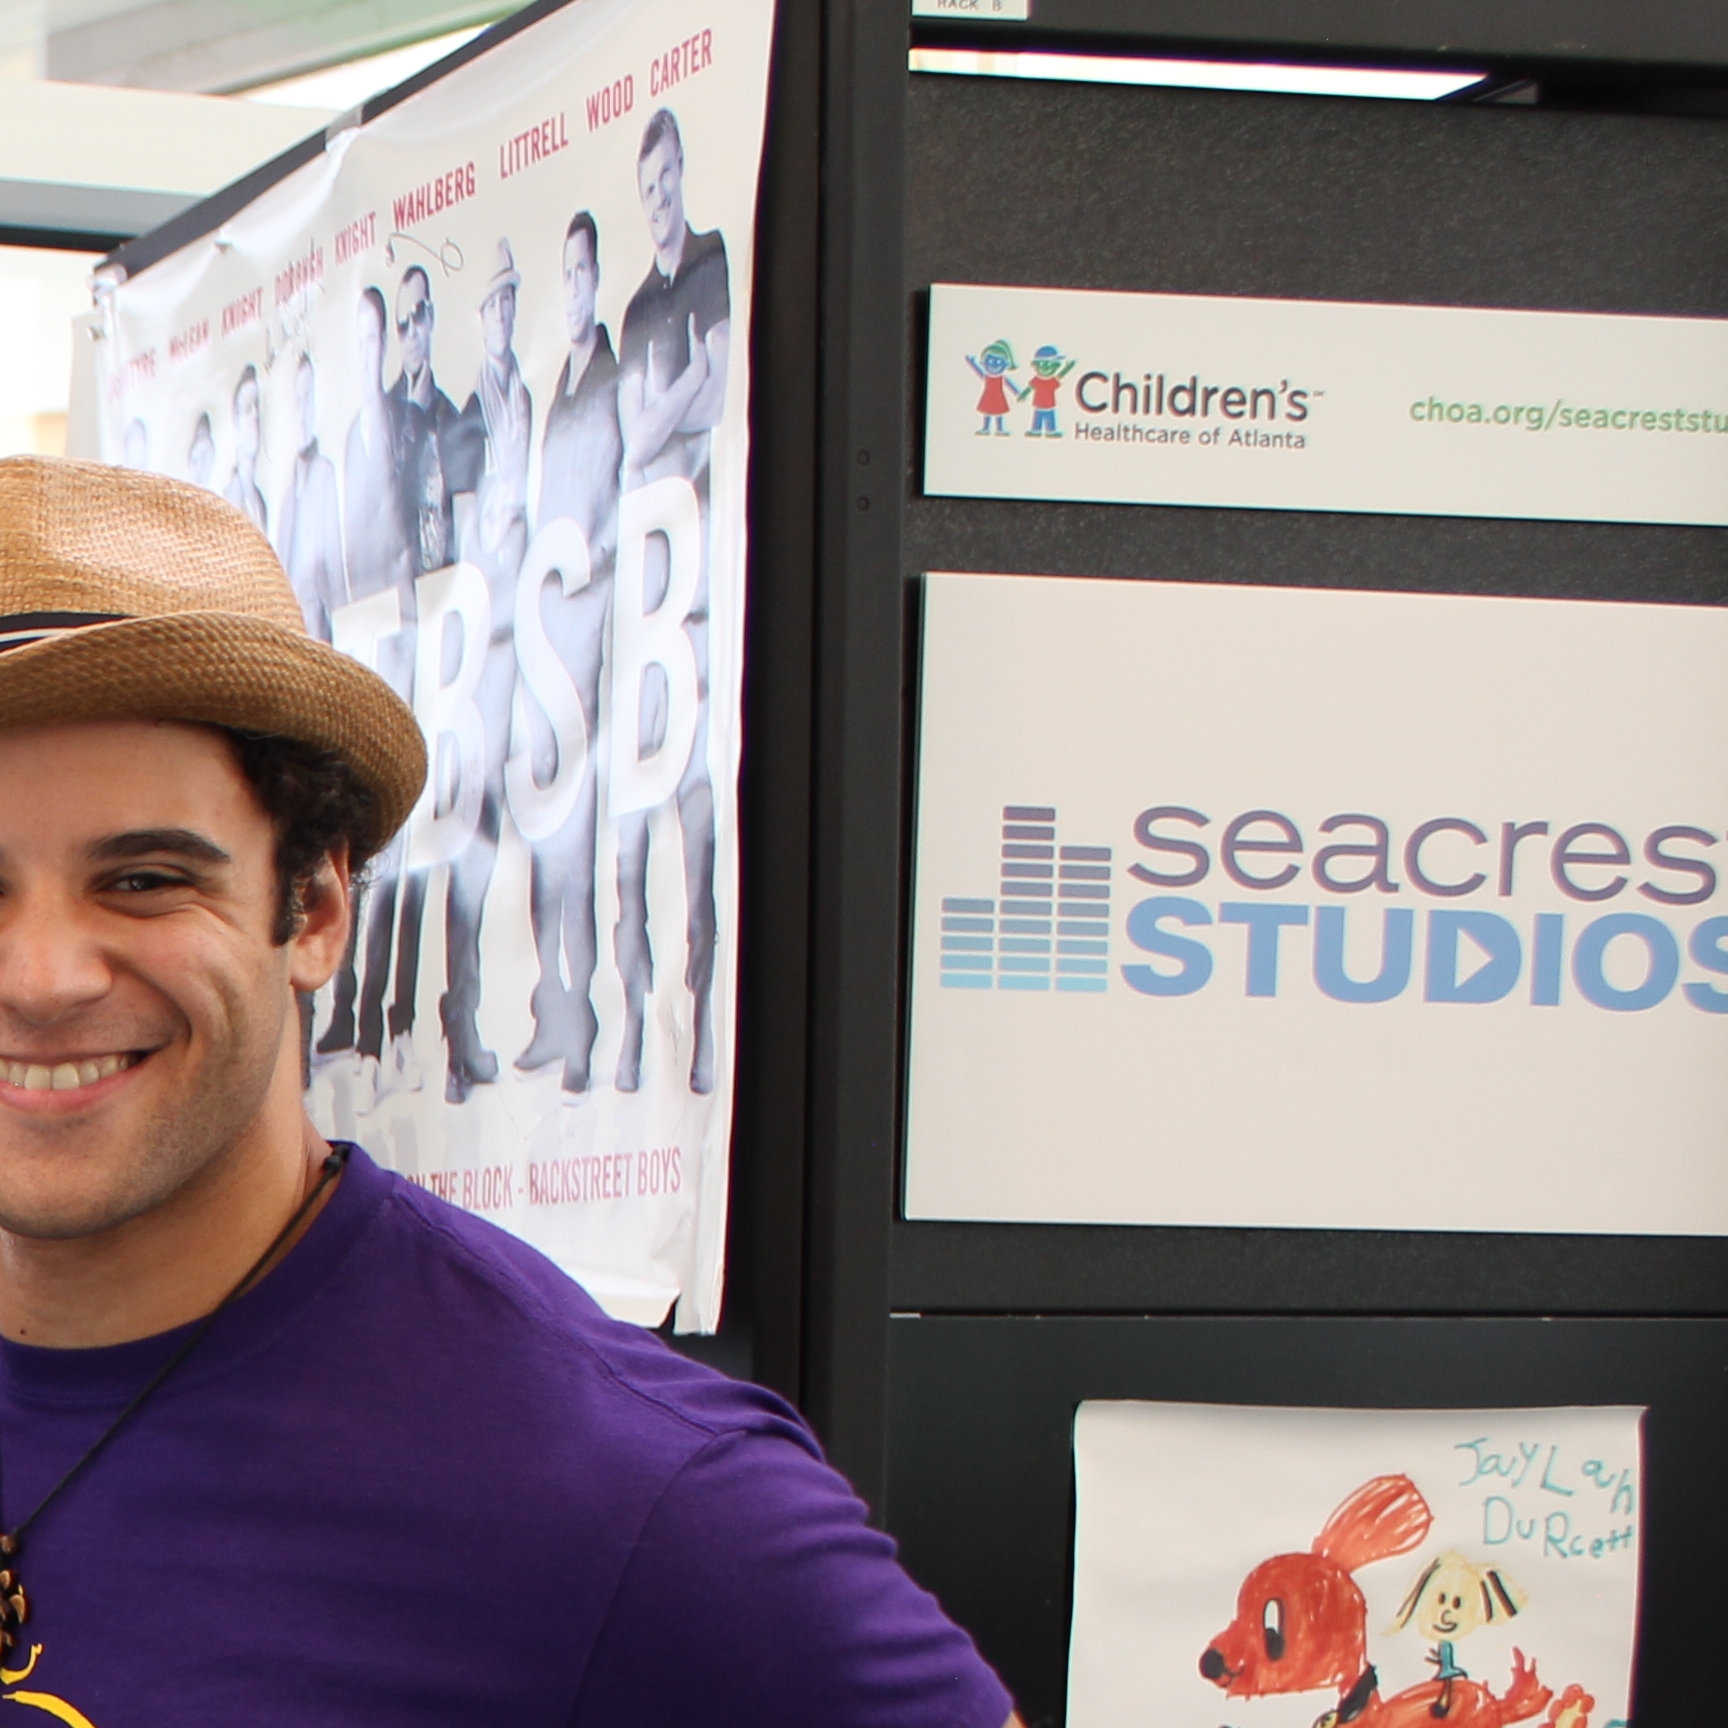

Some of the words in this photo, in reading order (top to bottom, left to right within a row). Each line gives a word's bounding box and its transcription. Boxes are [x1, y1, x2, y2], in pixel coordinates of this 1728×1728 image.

[392, 161, 477, 231] WAHLBERG
[500, 111, 570, 180] LITTRELL
[586, 74, 635, 133] WOOD
[650, 28, 713, 98] CARTER
[1074, 422, 1191, 444] Healthcare
[1197, 428, 1221, 446] of
[1228, 430, 1306, 449] Atlanta
[1126, 805, 1728, 906] seacres
[462, 1163, 514, 1212] BLOCK
[529, 1152, 633, 1206] BACKSTREET
[637, 1146, 682, 1196] BOYS
